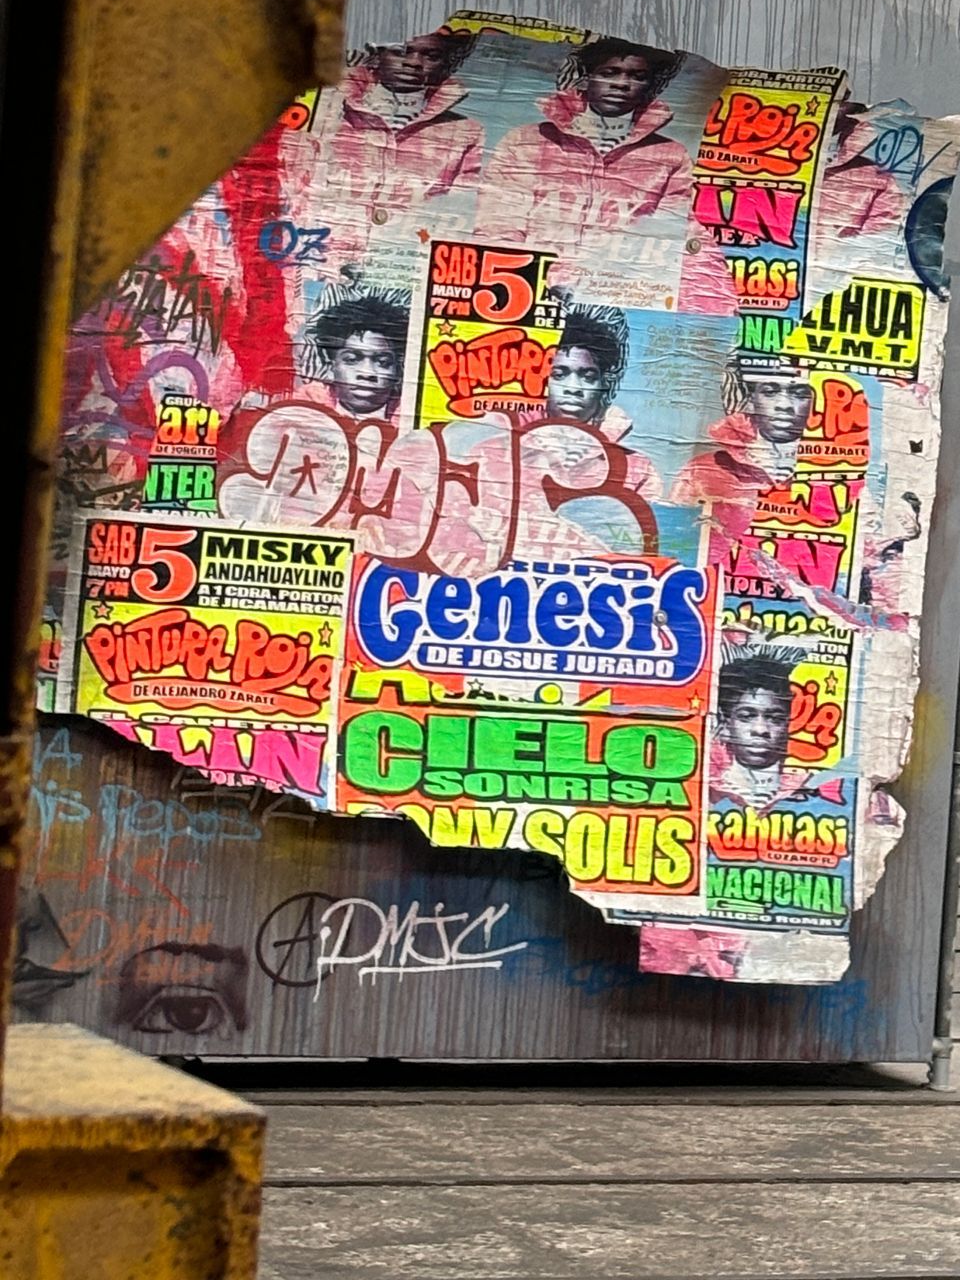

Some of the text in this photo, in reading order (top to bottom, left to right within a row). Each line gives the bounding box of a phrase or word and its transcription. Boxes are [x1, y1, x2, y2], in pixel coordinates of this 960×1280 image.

[432, 244, 477, 287] SAB
[473, 250, 535, 322] 5
[432, 283, 473, 298] MAYO
[88, 564, 131, 579] MAYO
[89, 523, 345, 603] SAB 5 MISKY
[204, 562, 344, 589] ANDAHUAYLINO
[199, 595, 342, 616] DE JICAMARCA
[281, 590, 343, 604] PORTON
[426, 646, 675, 679] DE JOSUE JURADO
[133, 685, 149, 697] DE
[152, 686, 226, 700] ALEJANDRO
[344, 709, 698, 794] CIELO
[422, 770, 690, 806] SONRISA
[523, 808, 695, 886] SOLIS
[706, 866, 848, 916] NACIONAL
